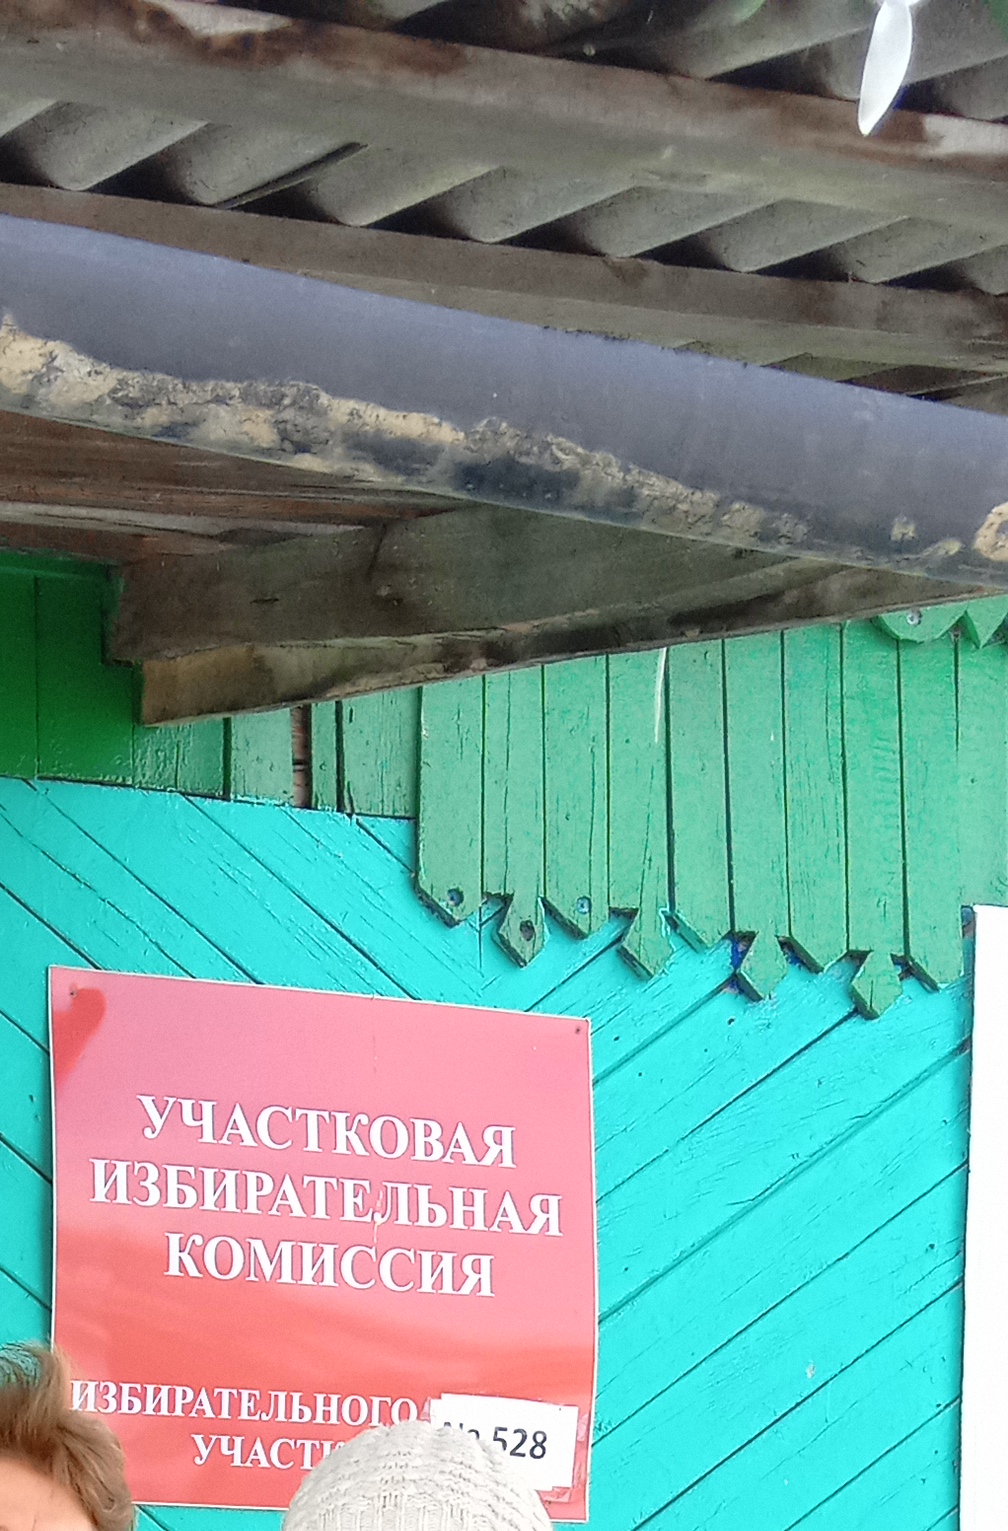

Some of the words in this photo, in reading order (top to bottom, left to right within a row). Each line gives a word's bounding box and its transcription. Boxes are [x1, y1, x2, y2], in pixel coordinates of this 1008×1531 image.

[136, 1093, 516, 1169] УЧАСТКОВАЯ
[89, 1157, 563, 1237] ИЗБИРАТЕЛЬНАЯ
[164, 1231, 495, 1297] КОМИССИЯ
[70, 1380, 418, 1428] ИЗБИРАТЕЛЬНОГО
[492, 1426, 548, 1460] 528
